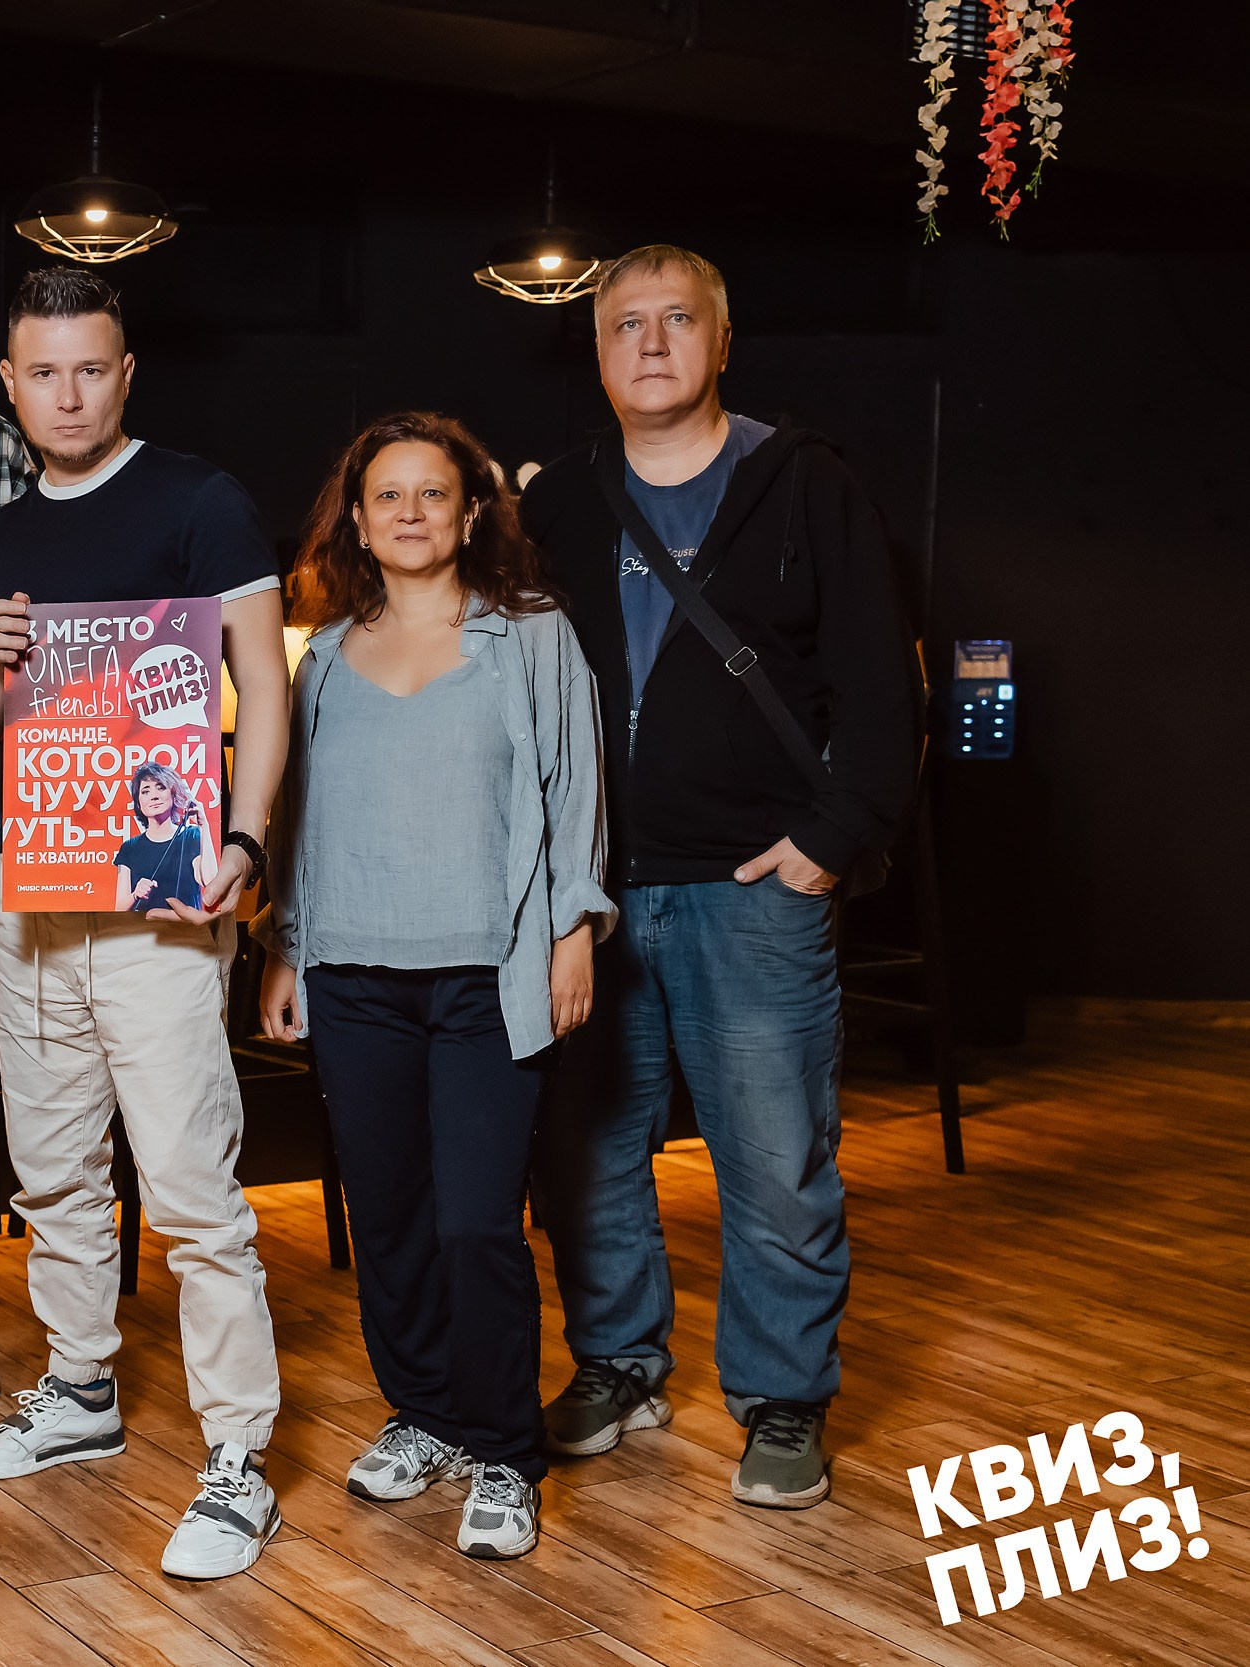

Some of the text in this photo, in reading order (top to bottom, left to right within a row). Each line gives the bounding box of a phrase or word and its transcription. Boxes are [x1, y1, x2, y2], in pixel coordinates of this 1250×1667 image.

[47, 616, 155, 643] МЕСТО
[130, 676, 210, 719] ПЛИЗ!
[17, 727, 112, 744] КОМАНДЕ,
[17, 735, 206, 778] КОТОРОЙ
[16, 852, 35, 864] НЕ
[38, 851, 108, 864] ХВАТИЛО
